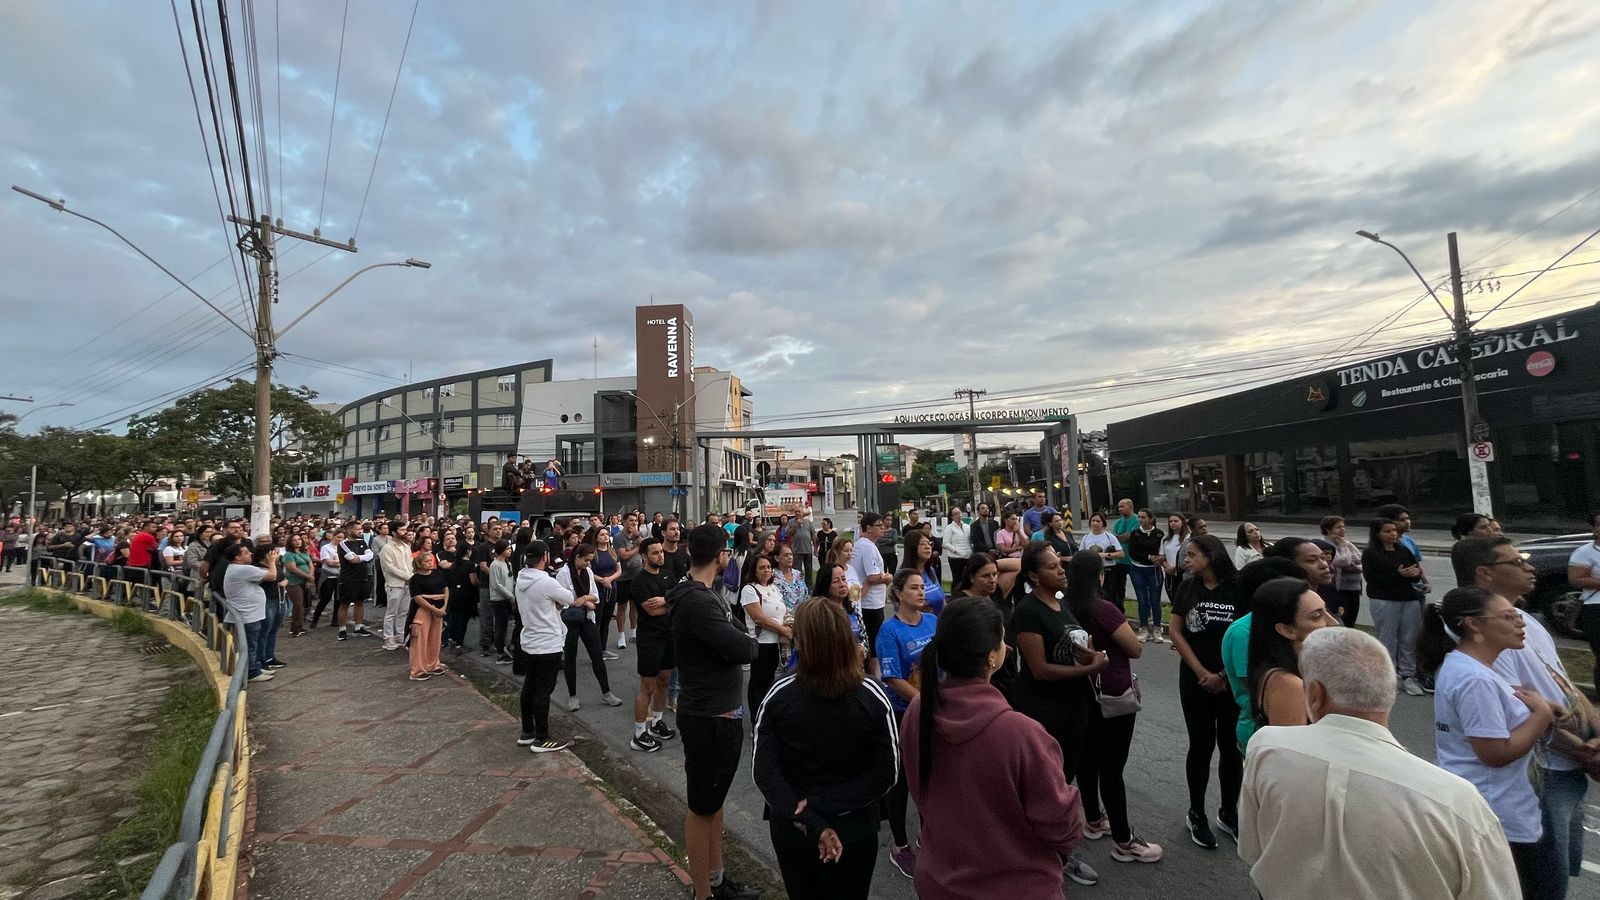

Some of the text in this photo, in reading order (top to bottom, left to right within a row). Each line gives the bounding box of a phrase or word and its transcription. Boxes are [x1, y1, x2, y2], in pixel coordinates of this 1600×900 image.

[667, 316, 678, 378] RAVENNA
[1337, 320, 1579, 387] TENDA CAEDRAL
[1381, 367, 1509, 398] Restaurante & Chuscaria
[894, 415, 914, 424] AQUI
[980, 410, 1008, 419] CORPO
[1009, 409, 1020, 418] EM
[1021, 407, 1069, 417] MOVIMENTO
[313, 485, 330, 497] REDE
